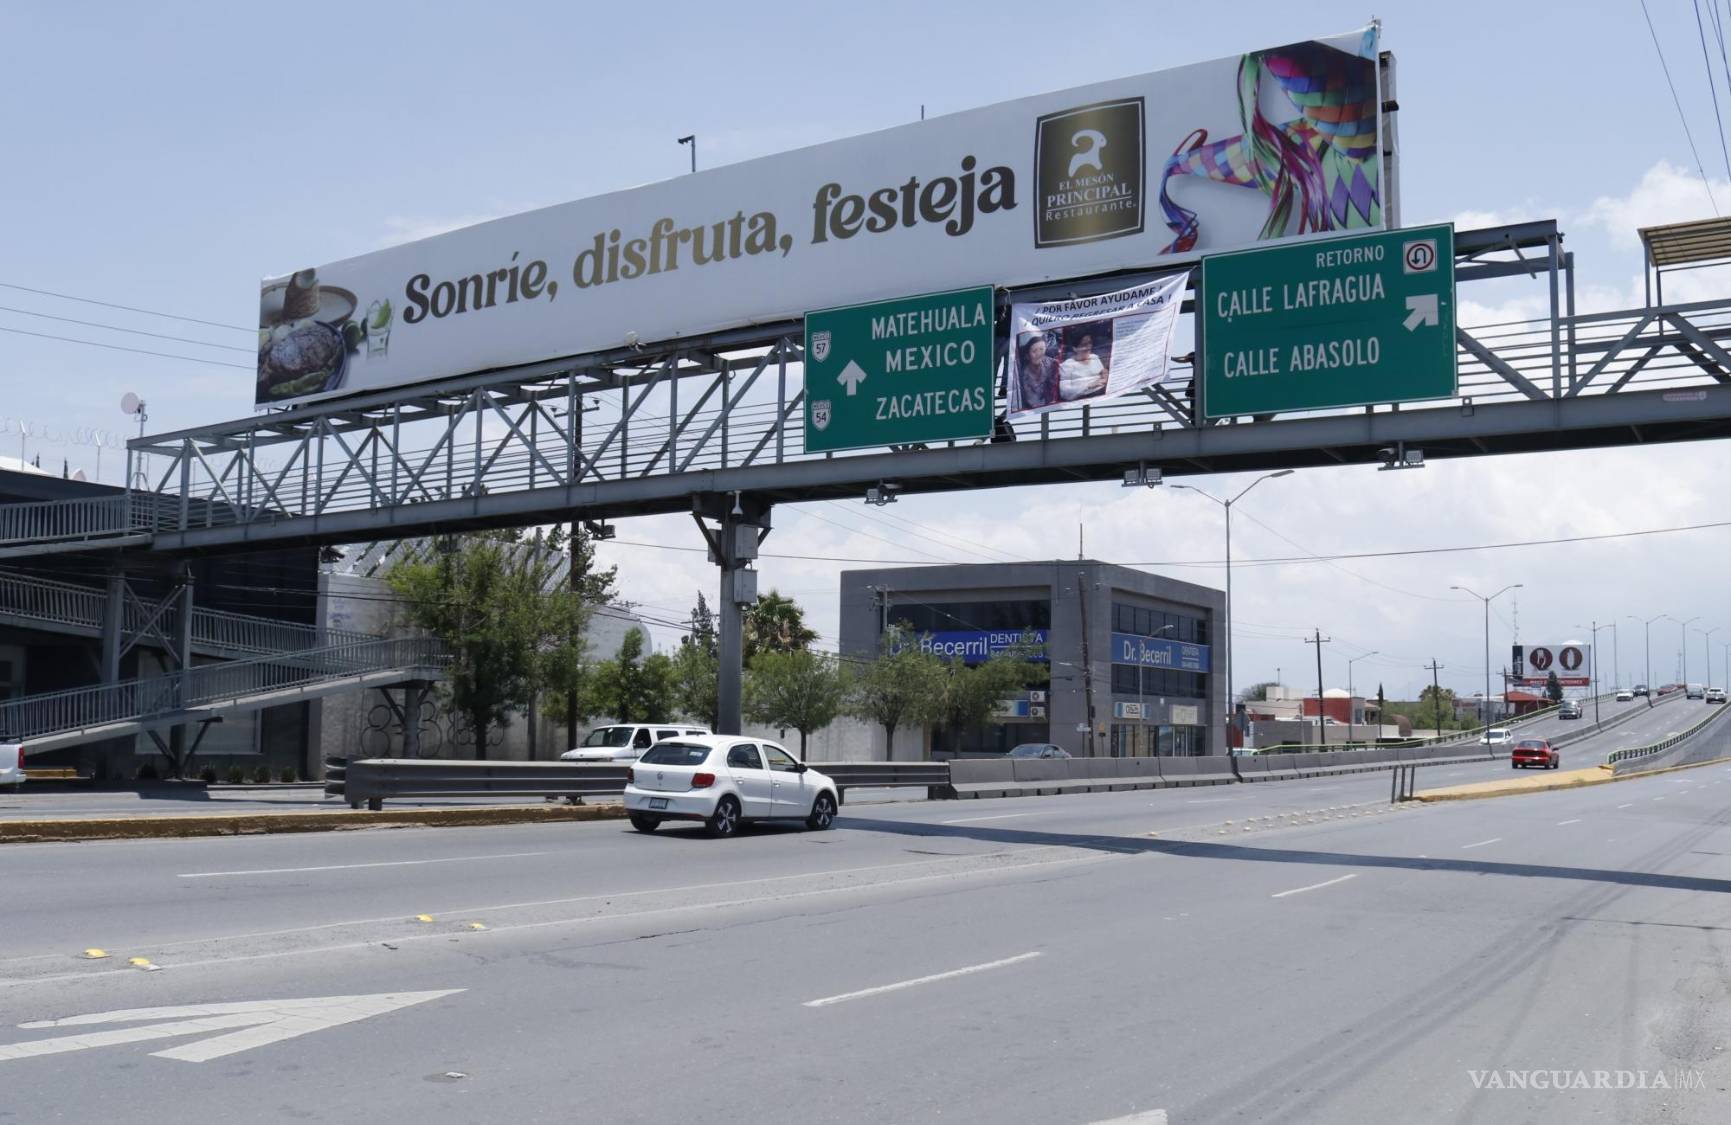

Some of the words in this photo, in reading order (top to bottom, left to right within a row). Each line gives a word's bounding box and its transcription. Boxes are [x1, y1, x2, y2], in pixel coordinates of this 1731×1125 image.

[1047, 182, 1132, 208] PRINCIPAL
[1059, 180, 1072, 191] EL
[403, 251, 558, 325] Sonríe,
[573, 210, 794, 289] disfruta,
[810, 155, 1018, 245] festeja
[1316, 245, 1385, 269] RETORNO
[1042, 304, 1062, 314] POR
[1064, 298, 1098, 311] FAVOR
[1217, 286, 1273, 318] CALLE
[1284, 273, 1385, 310] LAFRAGUA
[871, 303, 986, 340] MATEHUALA
[816, 343, 826, 354] 57
[885, 340, 975, 373] MEXICO
[1224, 348, 1280, 378] CALLE
[1290, 337, 1380, 372] ABASOLO
[876, 387, 986, 420] ZACATECAS
[816, 412, 826, 423] 54
[1124, 640, 1137, 661] Dr.
